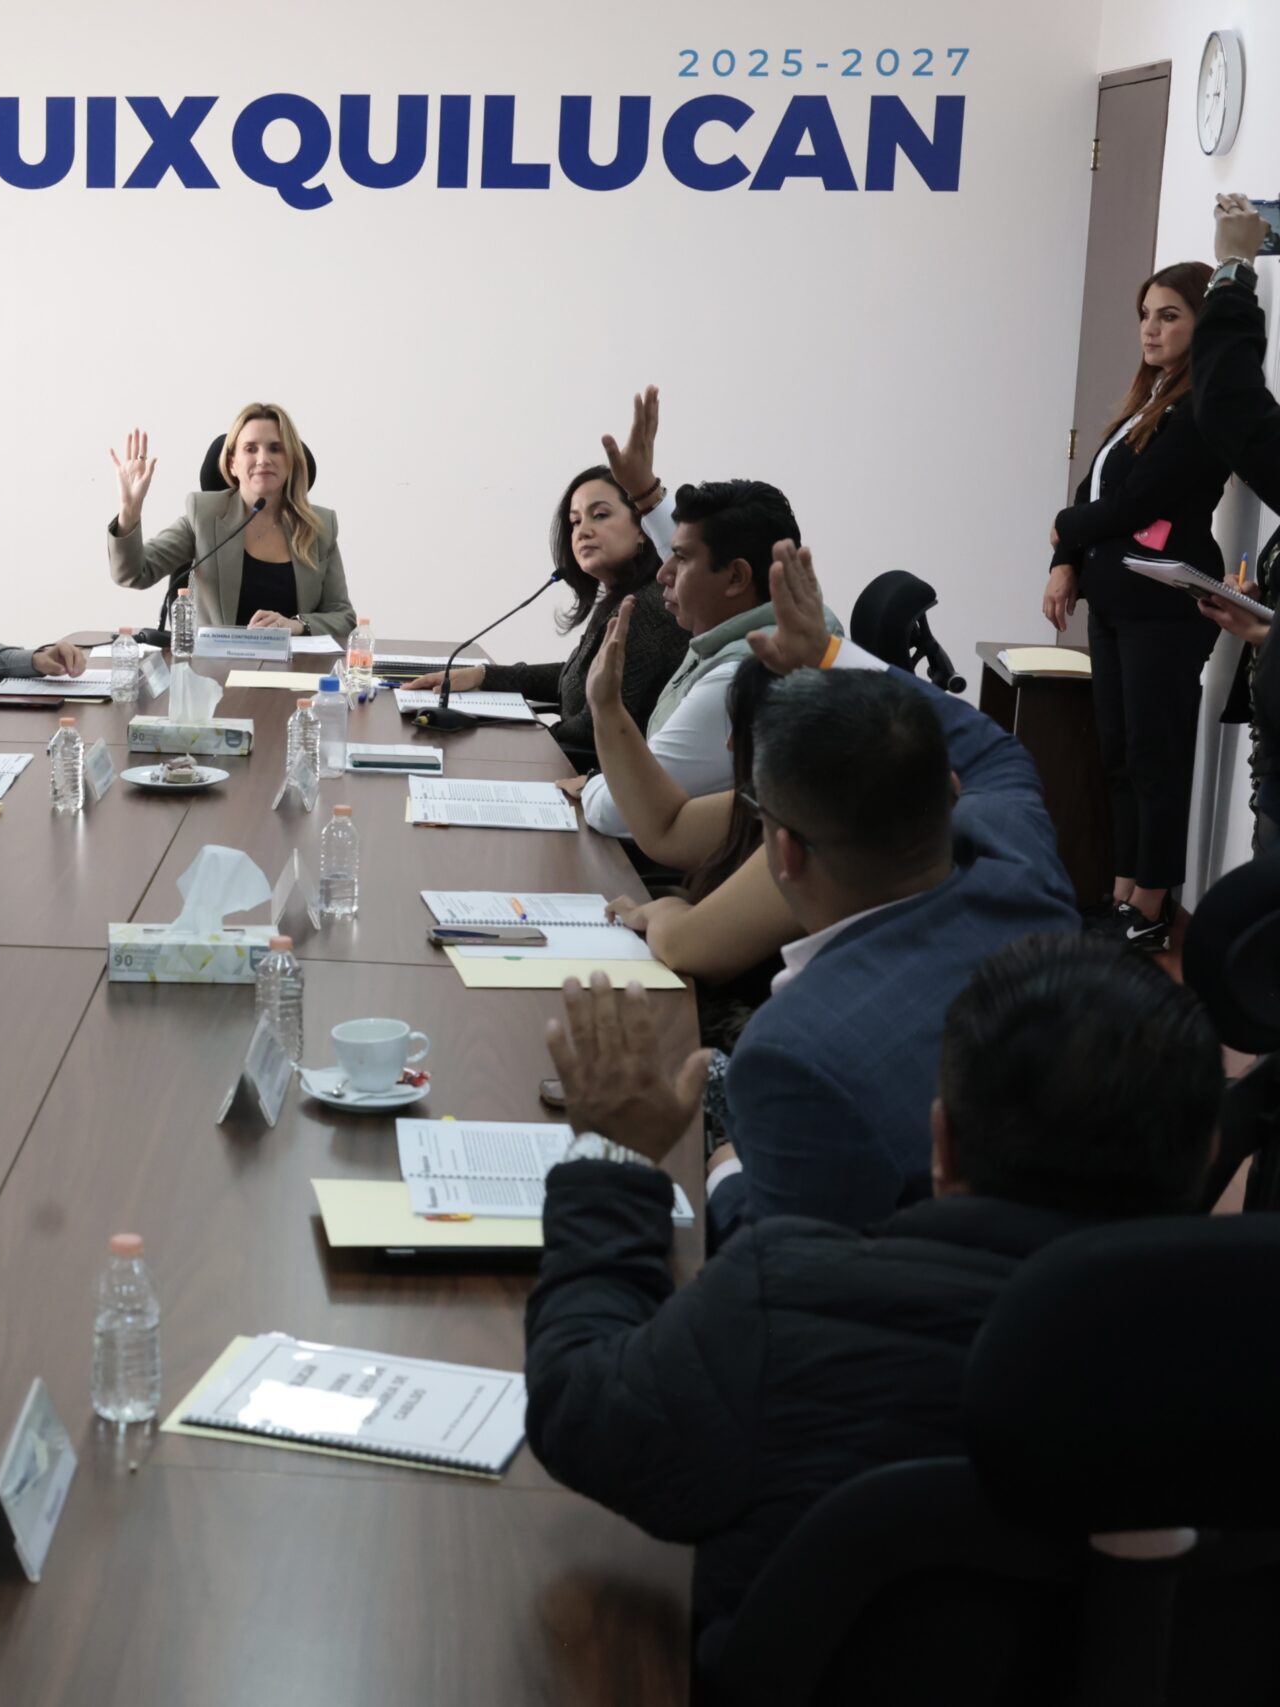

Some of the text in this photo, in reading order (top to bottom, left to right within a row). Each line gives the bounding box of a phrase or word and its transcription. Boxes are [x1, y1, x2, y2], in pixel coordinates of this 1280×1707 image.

[678, 48, 970, 77] 2025-2027
[131, 732, 145, 742] 90
[113, 954, 134, 967] 90
